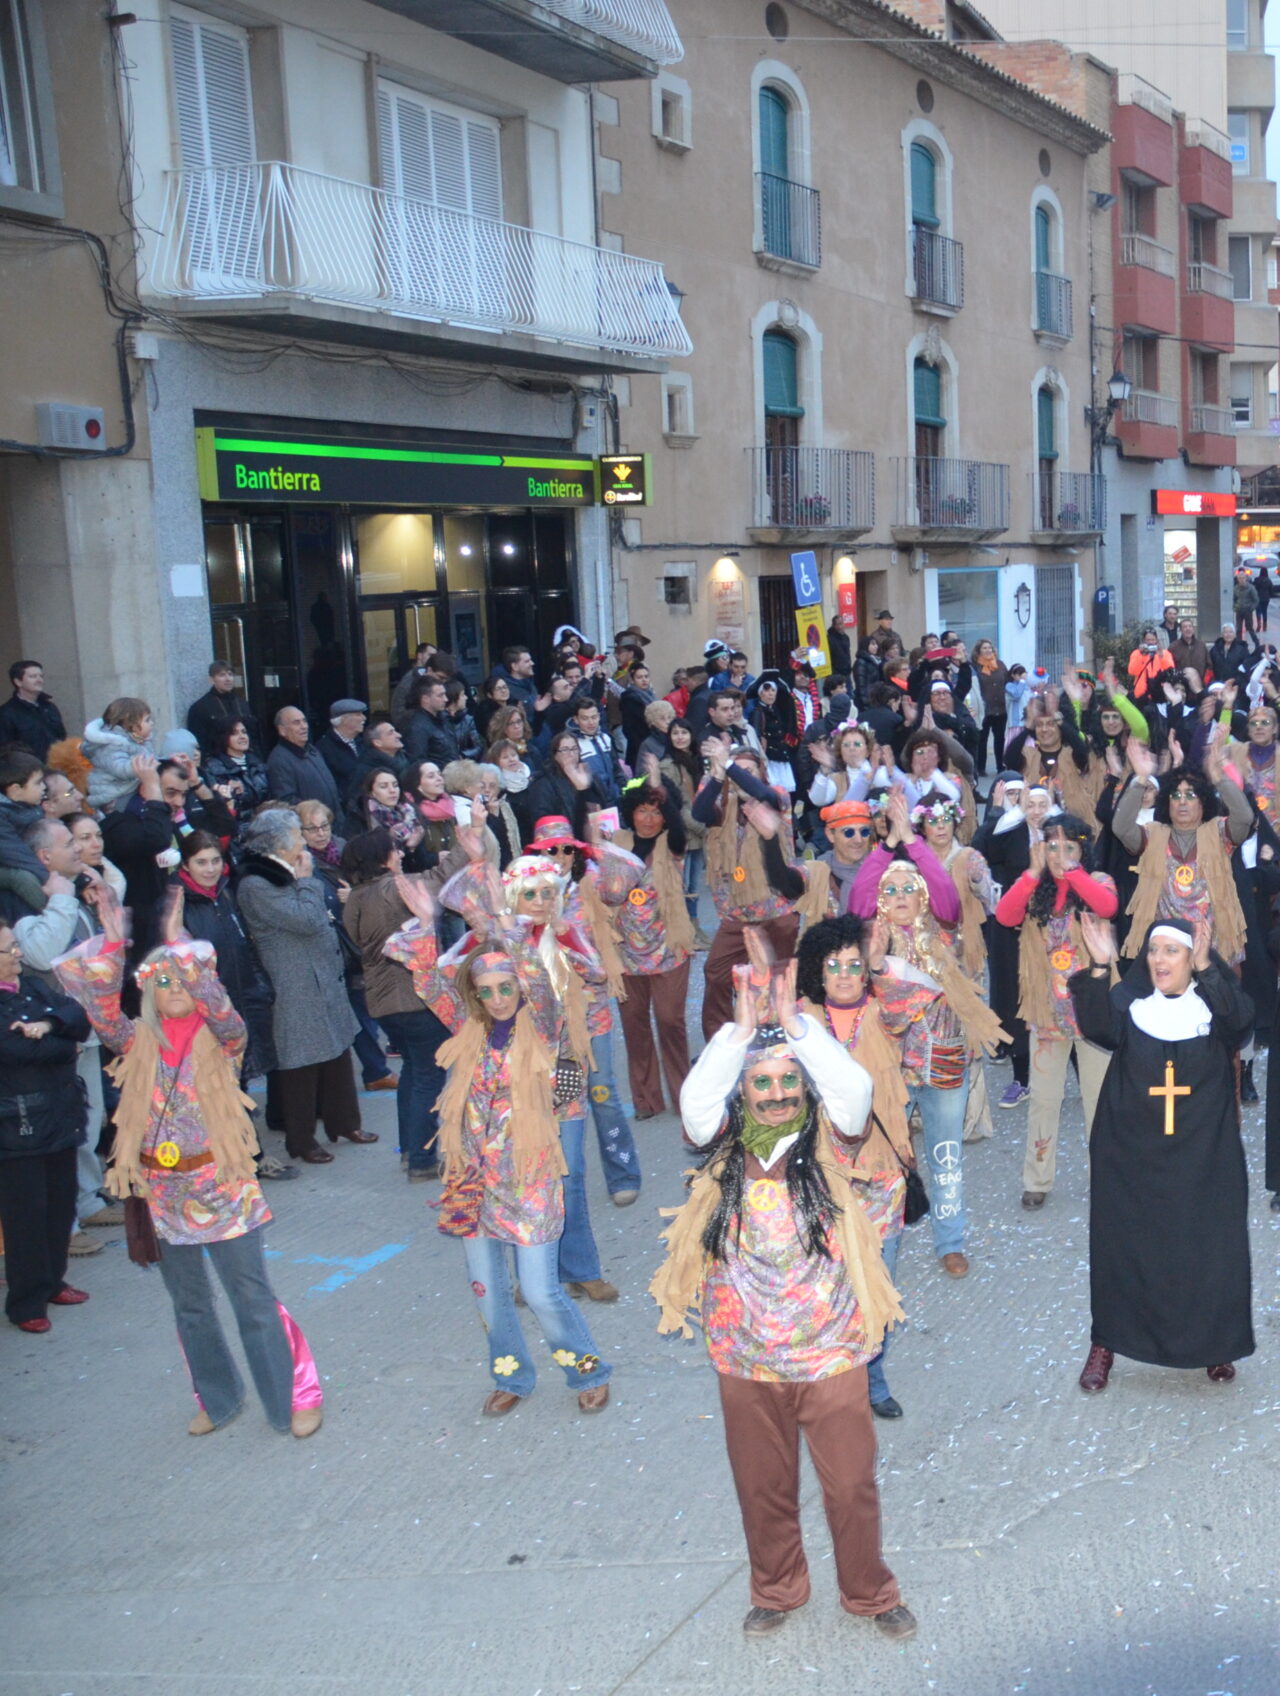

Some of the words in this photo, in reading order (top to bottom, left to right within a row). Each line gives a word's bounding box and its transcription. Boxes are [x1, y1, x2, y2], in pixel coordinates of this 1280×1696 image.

[235, 463, 321, 491] Bantierra
[527, 476, 584, 499] Bantierra
[1098, 591, 1107, 602] P
